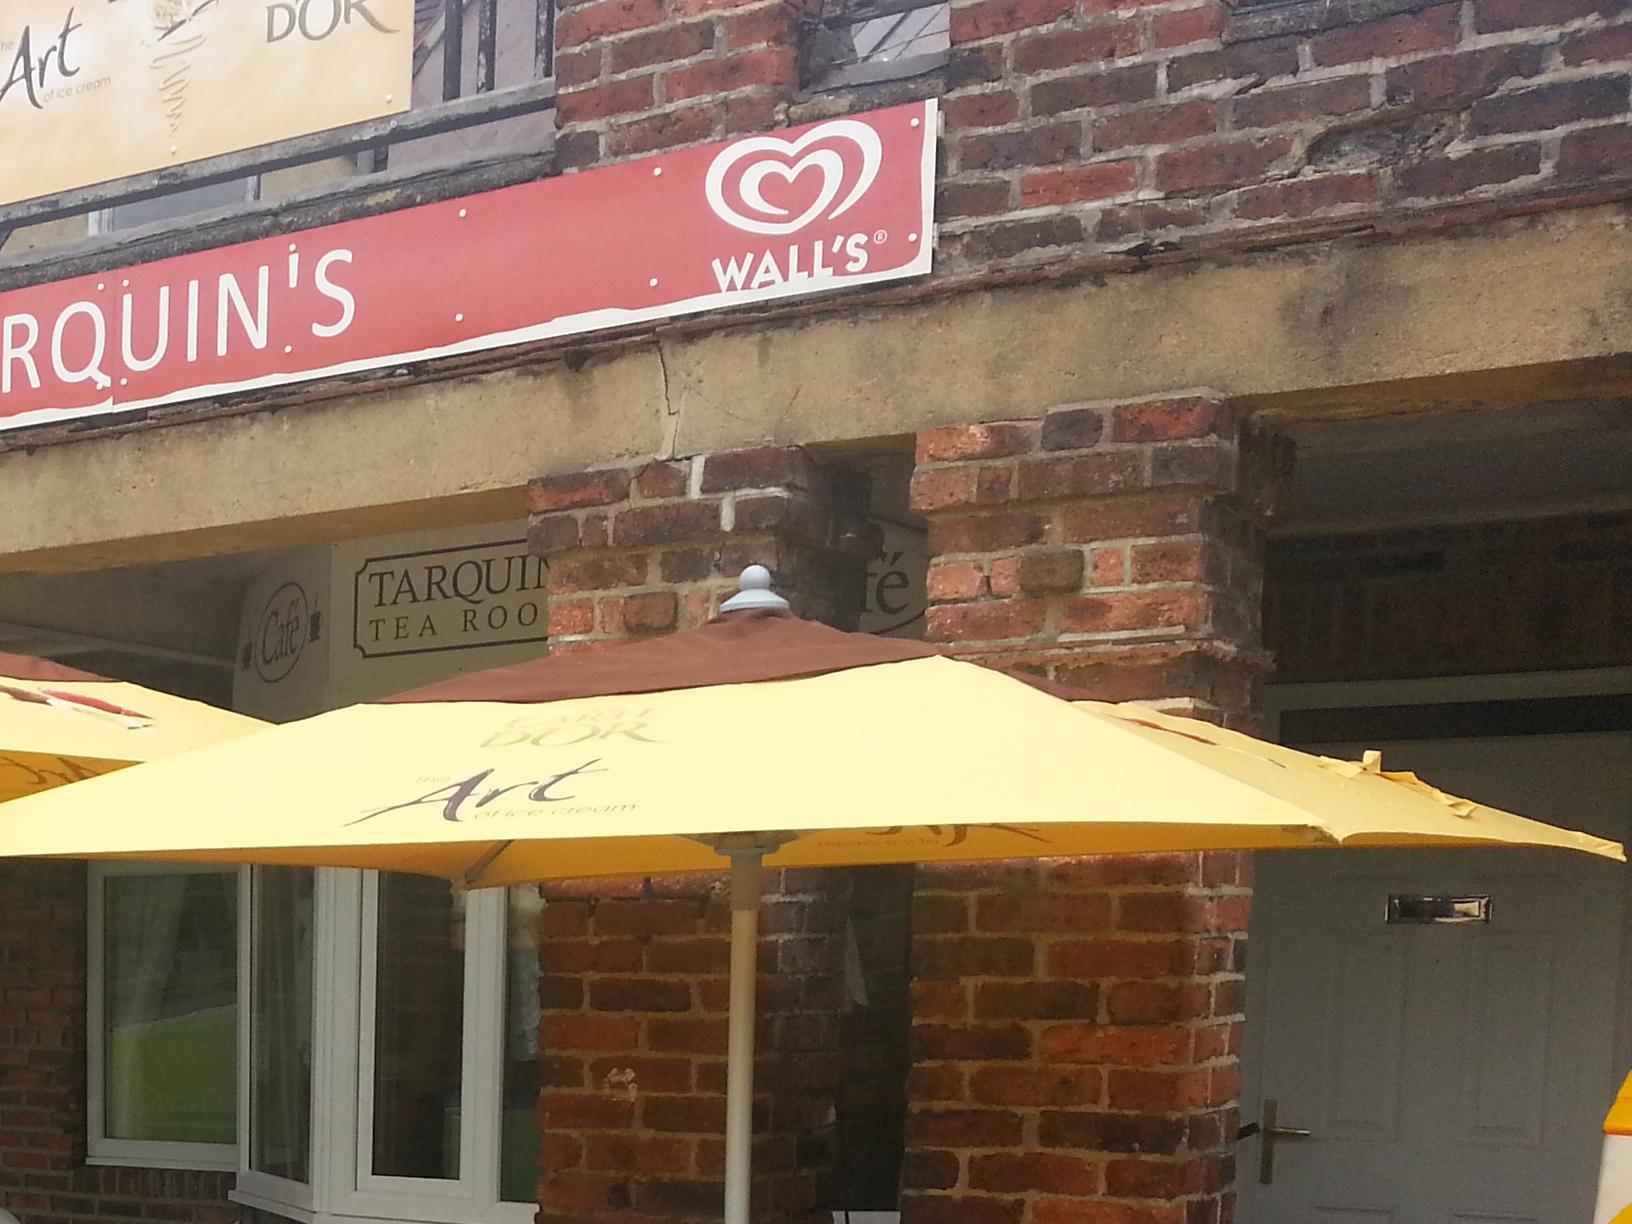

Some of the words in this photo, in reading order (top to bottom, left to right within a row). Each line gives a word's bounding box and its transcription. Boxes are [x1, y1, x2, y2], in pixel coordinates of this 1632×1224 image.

[711, 233, 869, 293] WALL'S
[261, 598, 301, 667] Café
[369, 613, 438, 643] TEA
[462, 601, 539, 633] ROO
[342, 757, 610, 827] Art
